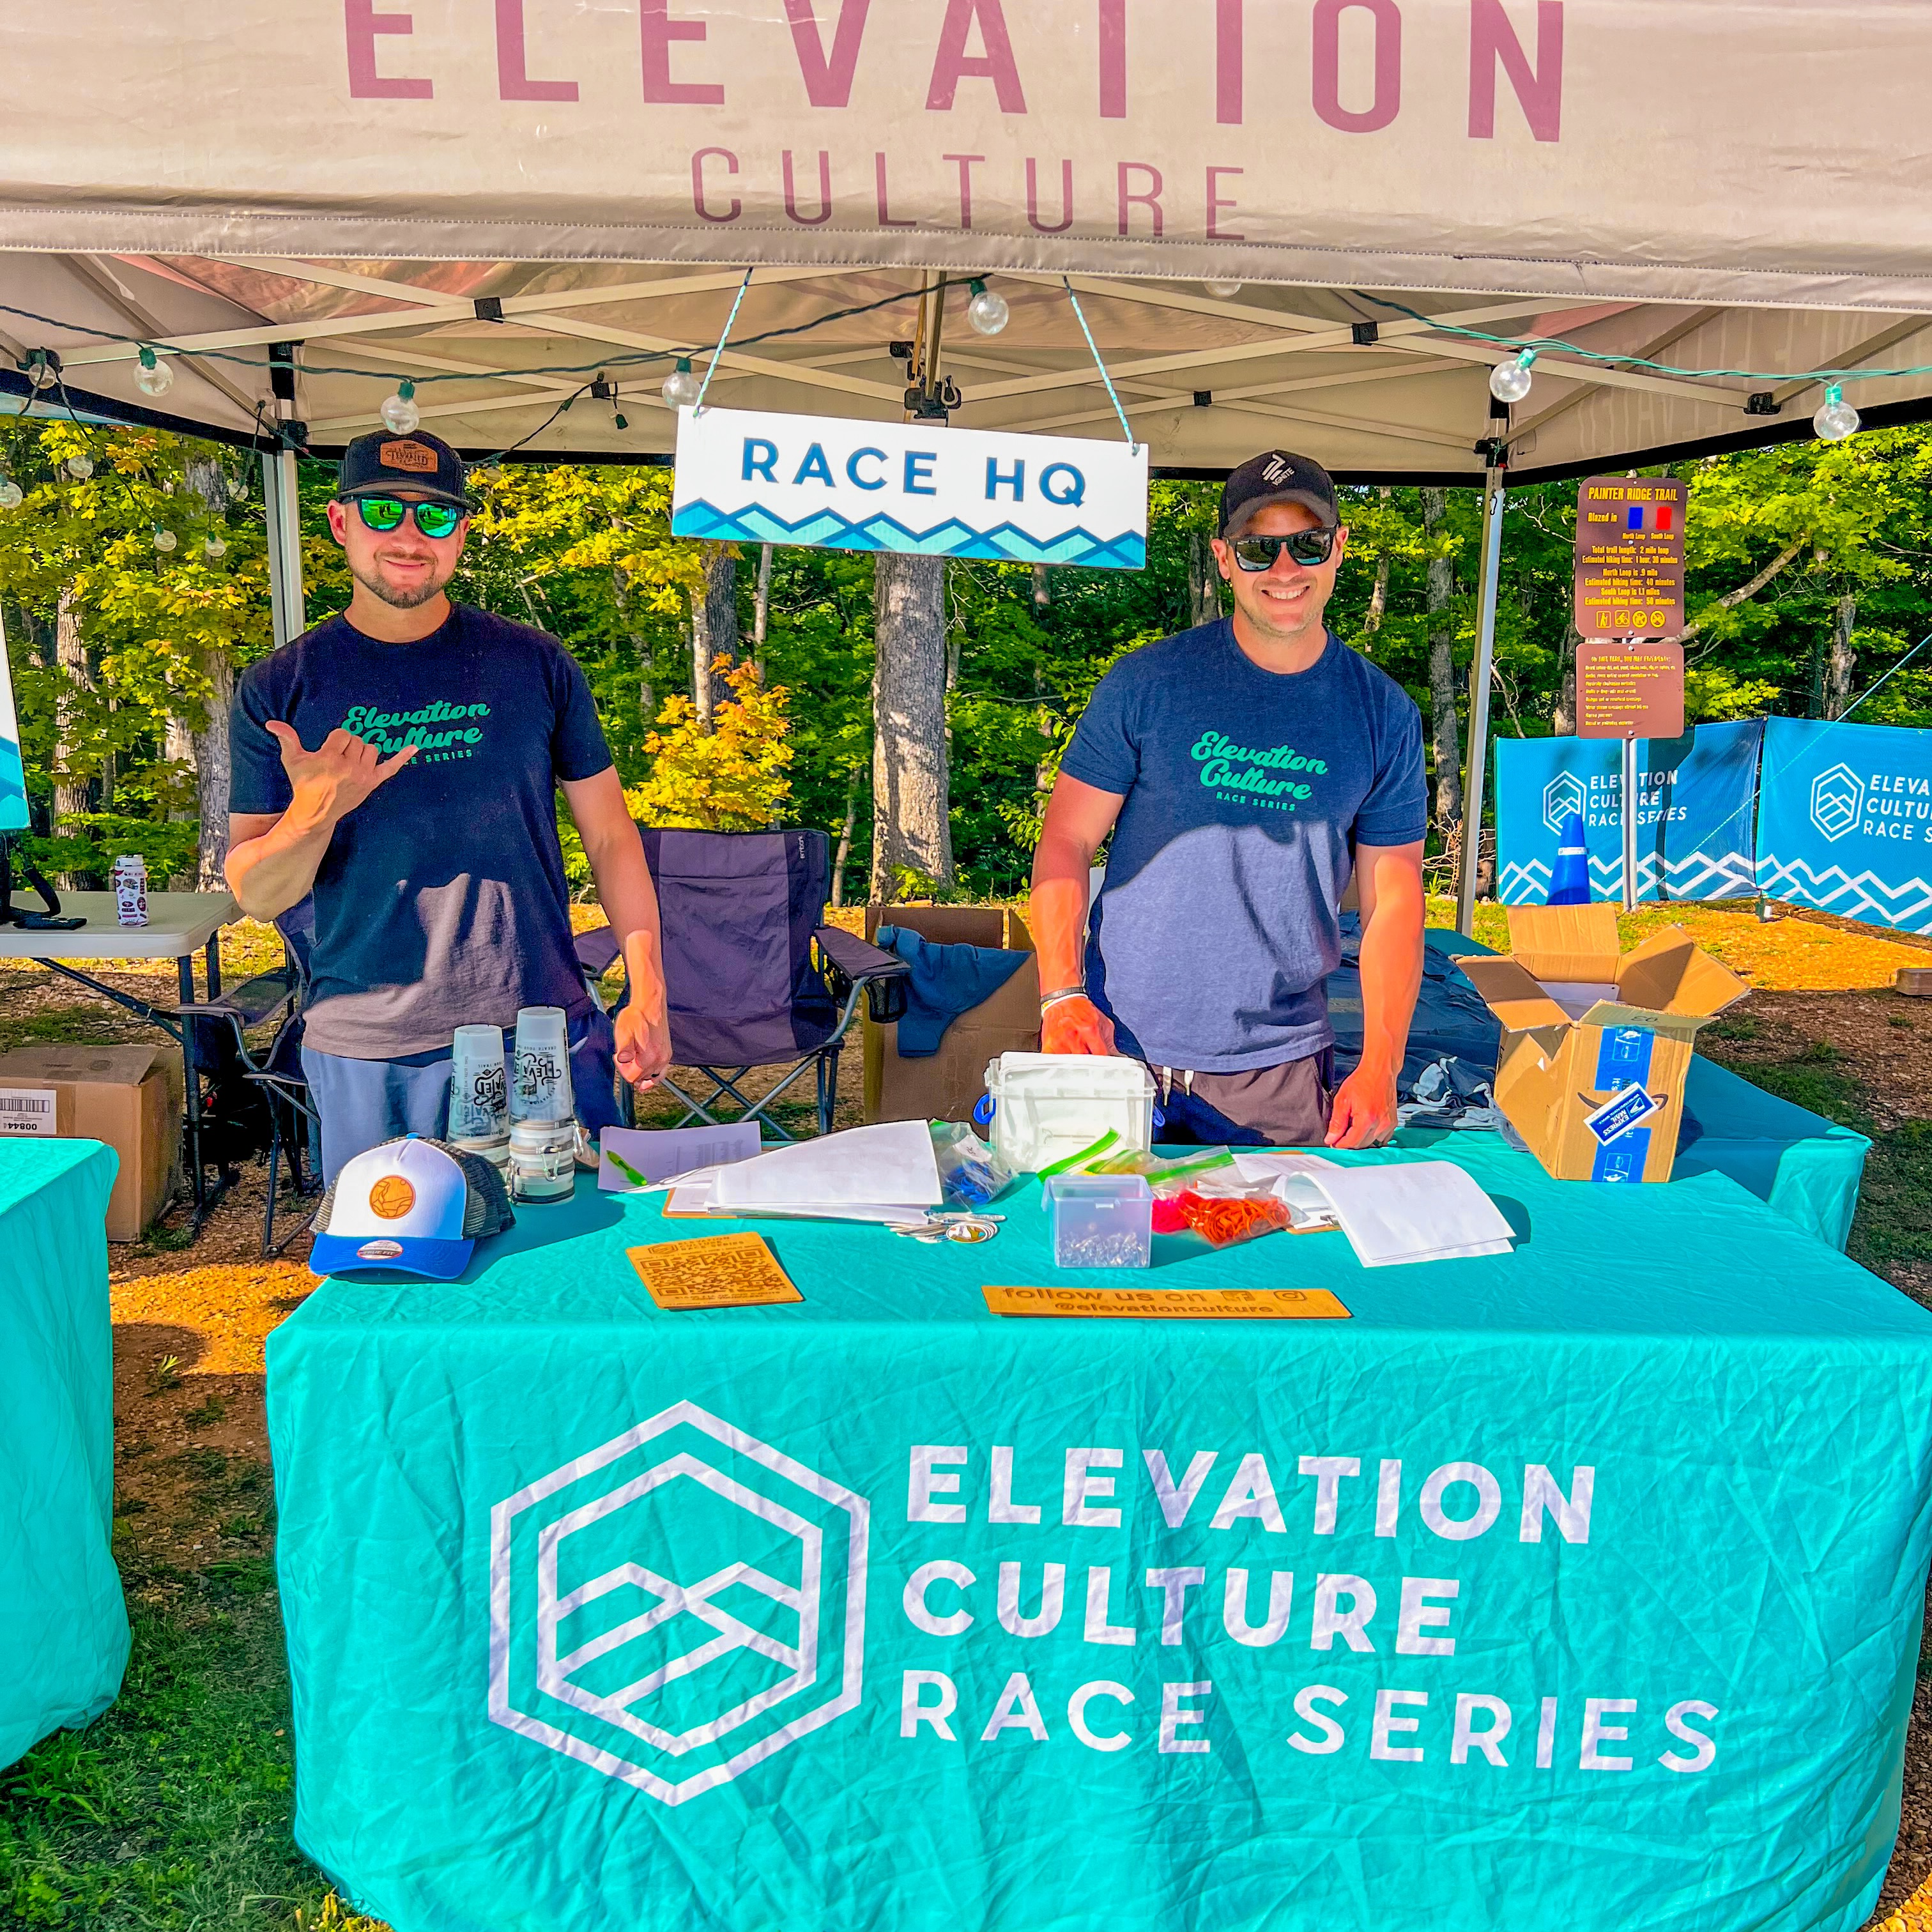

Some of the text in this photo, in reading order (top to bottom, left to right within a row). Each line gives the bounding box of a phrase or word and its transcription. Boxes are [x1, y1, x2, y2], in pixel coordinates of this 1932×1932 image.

[346, 0, 1563, 142] ELEVATION
[691, 147, 1245, 241] CULTURE
[742, 438, 1085, 508] RACE HQ
[1588, 487, 1678, 501] PAINTER RIDGE TRAIL
[1588, 512, 1618, 522] Blazed in
[1591, 546, 1604, 554] Total
[1606, 546, 1617, 554] trail
[1584, 578, 1611, 586] Estimated
[1613, 578, 1629, 586] hiking
[1603, 568, 1618, 576] North
[1619, 569, 1632, 577] Loop
[1613, 597, 1629, 606] hiking
[1655, 597, 1676, 606] minutes
[1618, 588, 1630, 596] Loop
[341, 700, 491, 735] Elevation
[360, 726, 483, 755] Culture
[425, 749, 472, 763] SERIES
[1190, 731, 1328, 775] Elevation
[1200, 758, 1312, 800] Culture
[1590, 769, 1678, 790] ELETION
[1869, 774, 1930, 796] ELEVA
[1216, 792, 1296, 811] RACE SERIES
[1590, 791, 1660, 809] CULRE
[1866, 797, 1932, 820] CULTU
[1588, 812, 1623, 827] RAC
[1863, 820, 1914, 841] RACE
[1610, 1108, 1627, 1122] MAIL
[1603, 1115, 1630, 1137] EXPRESS
[1003, 1288, 1207, 1302] follow us on
[1055, 1303, 1273, 1313] @elevationculture
[907, 1444, 1596, 1545] ELEVATION
[903, 1559, 1460, 1657] CULTURE
[900, 1669, 1720, 1774] RACE SERIES
